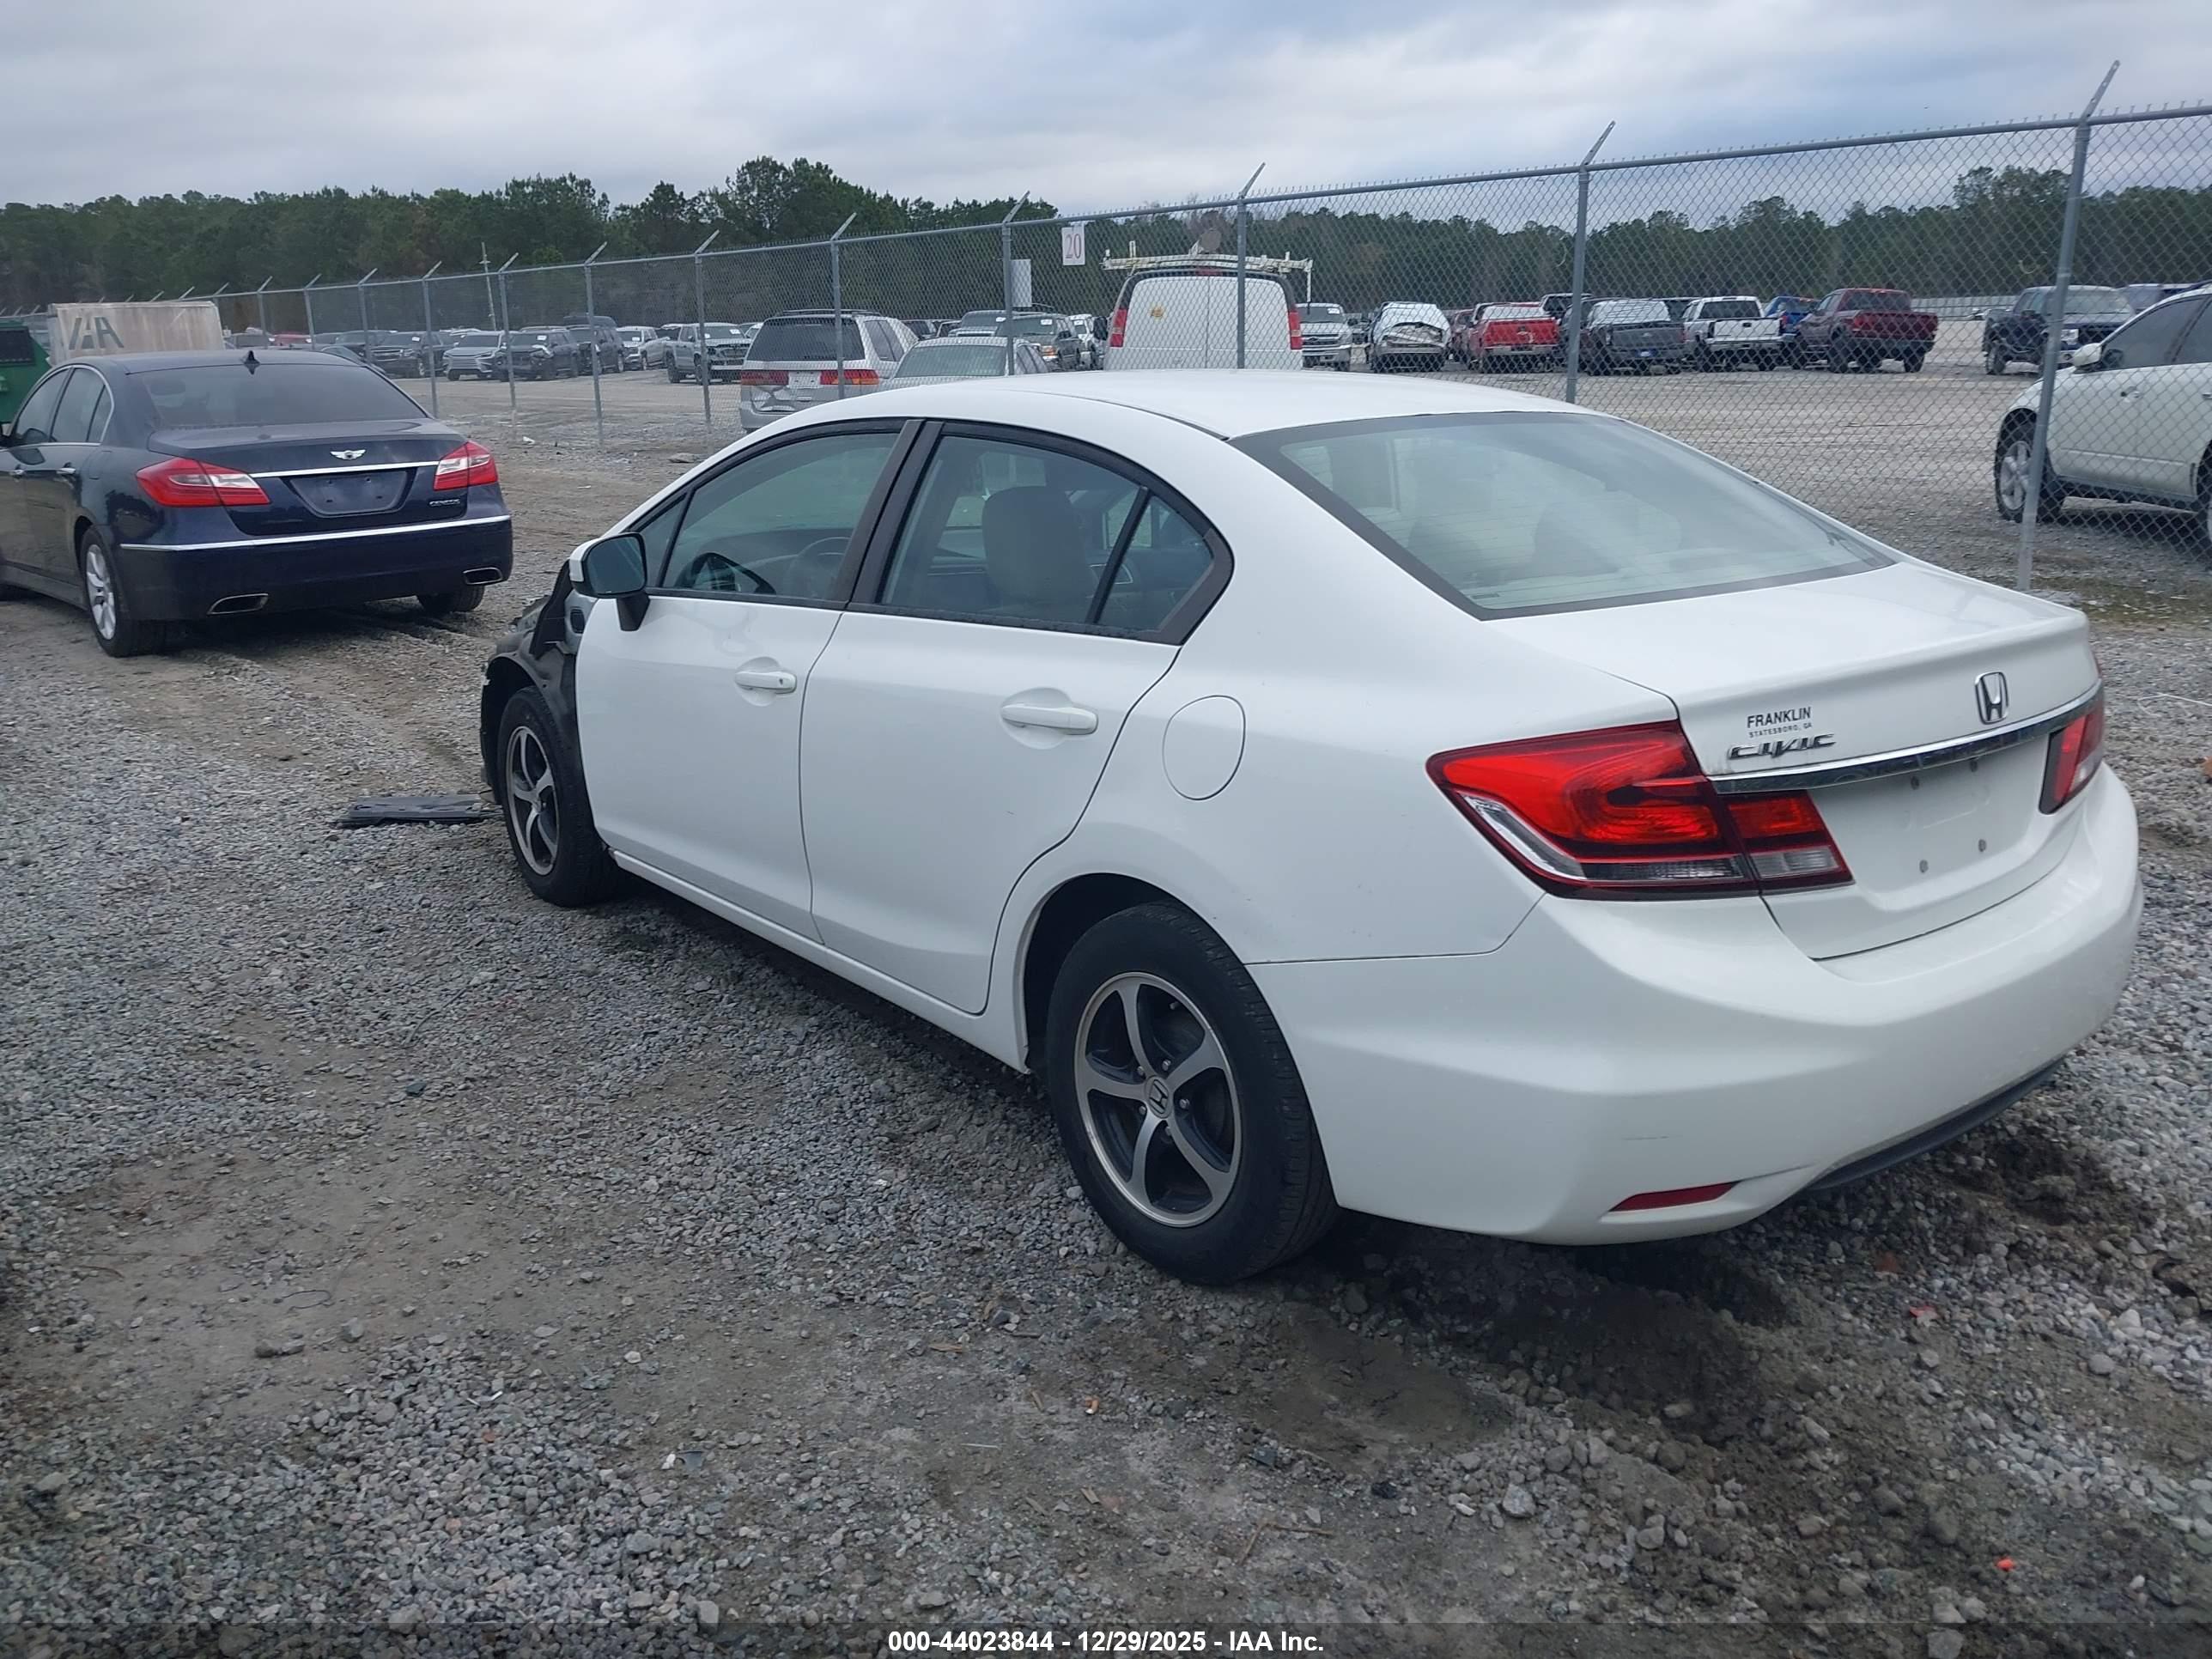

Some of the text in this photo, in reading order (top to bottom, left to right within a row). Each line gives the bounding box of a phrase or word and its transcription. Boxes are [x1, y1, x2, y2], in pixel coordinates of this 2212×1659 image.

[1065, 233, 1082, 259] 20
[1747, 706, 1812, 729] FRANKLIN
[1726, 733, 1837, 760] CIVIC
